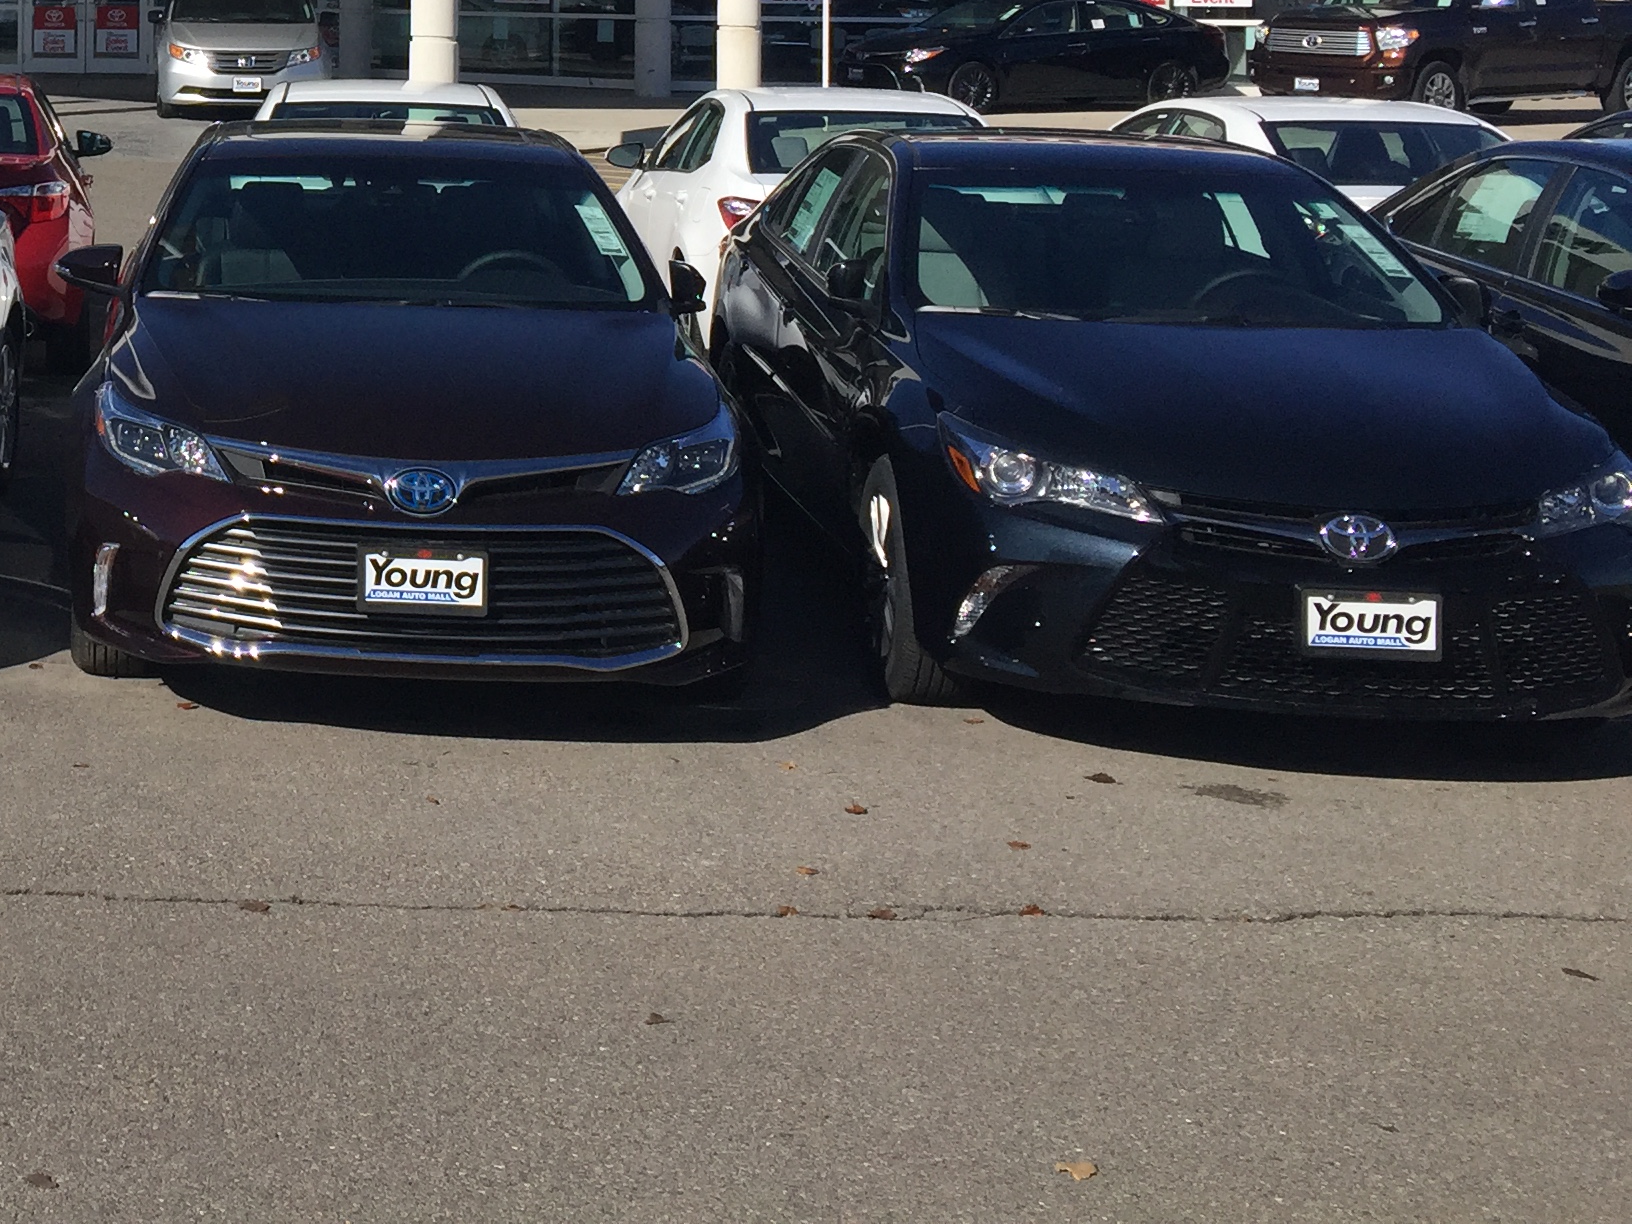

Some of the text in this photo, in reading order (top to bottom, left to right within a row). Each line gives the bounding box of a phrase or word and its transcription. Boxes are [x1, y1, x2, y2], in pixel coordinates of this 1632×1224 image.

[235, 79, 260, 89] Young
[369, 558, 480, 600] Young
[370, 590, 451, 601] LOGAN AUTO MALL
[1313, 602, 1432, 645] Young
[1314, 635, 1403, 646] LOGAN AUTO MALL
